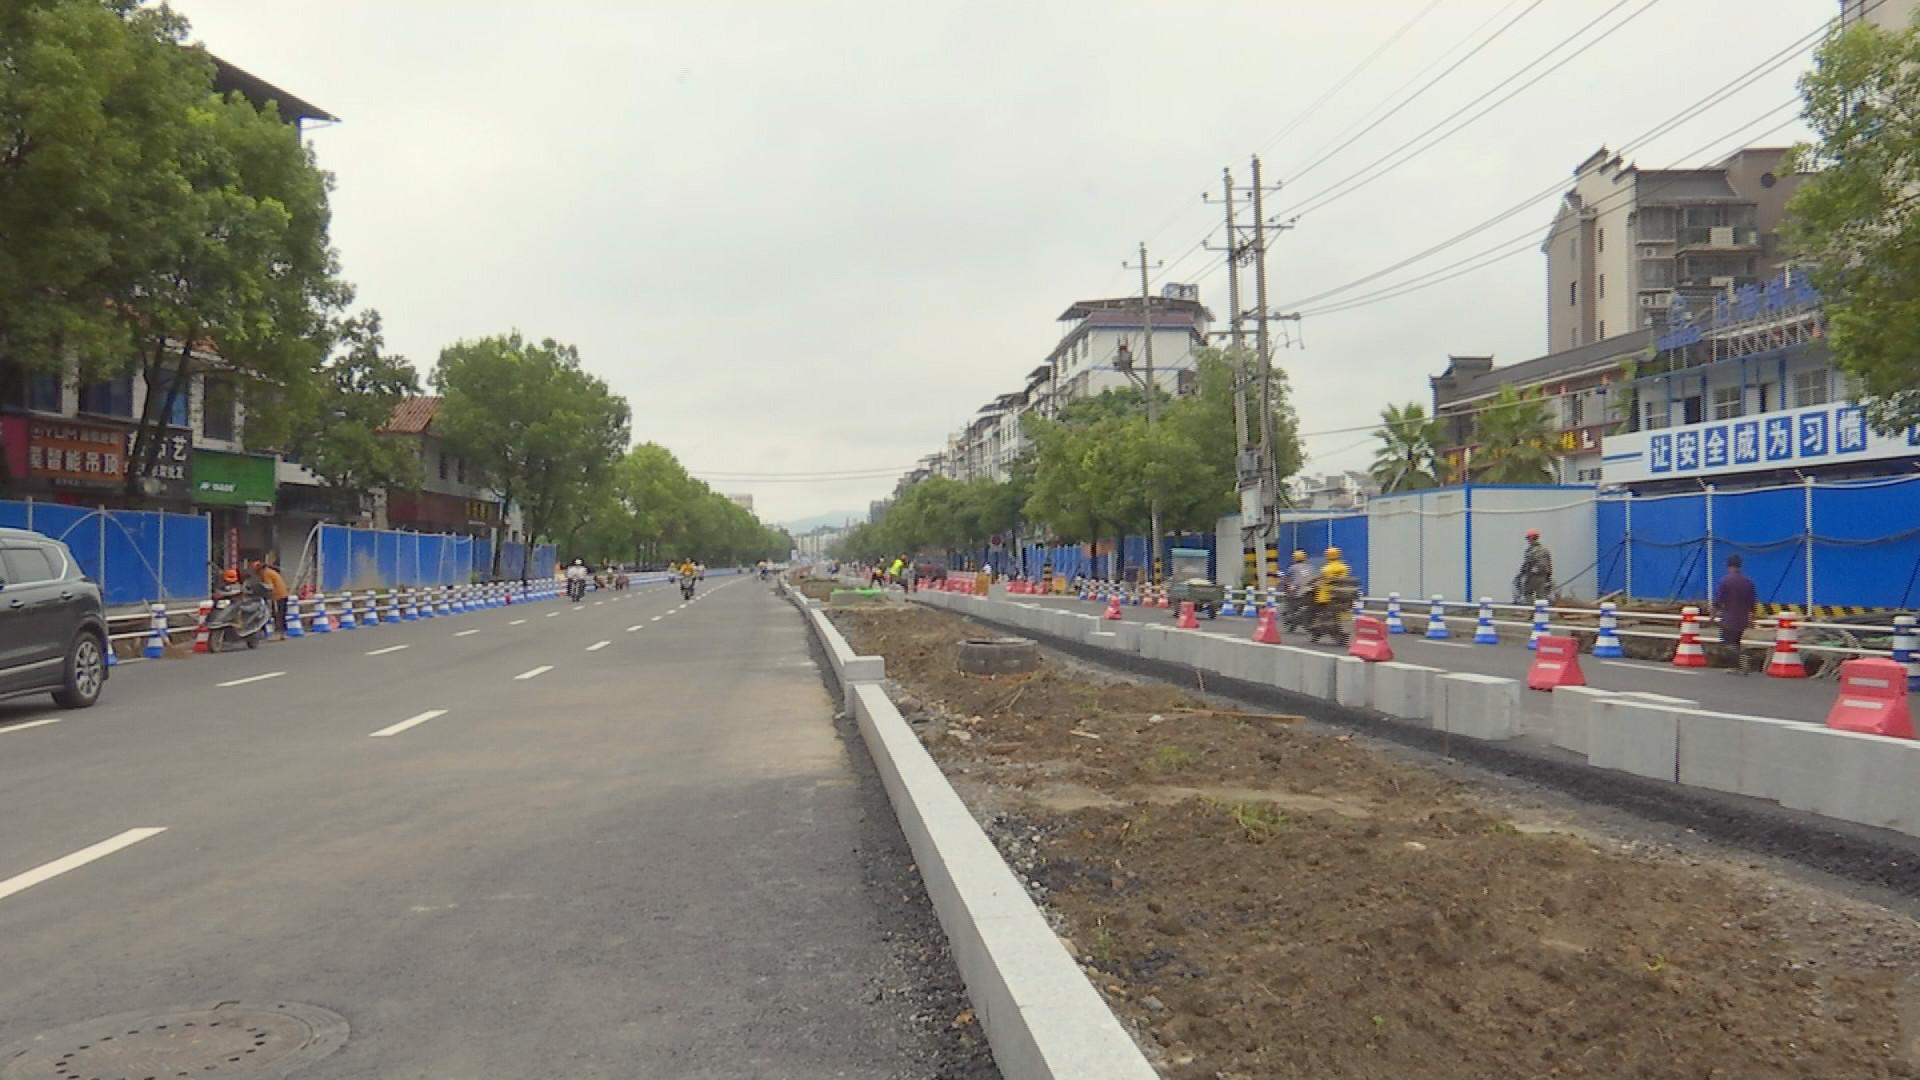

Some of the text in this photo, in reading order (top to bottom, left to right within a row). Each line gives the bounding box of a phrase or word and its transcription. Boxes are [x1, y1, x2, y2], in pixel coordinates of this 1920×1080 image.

[1652, 411, 1864, 471] 让安全成为习惯
